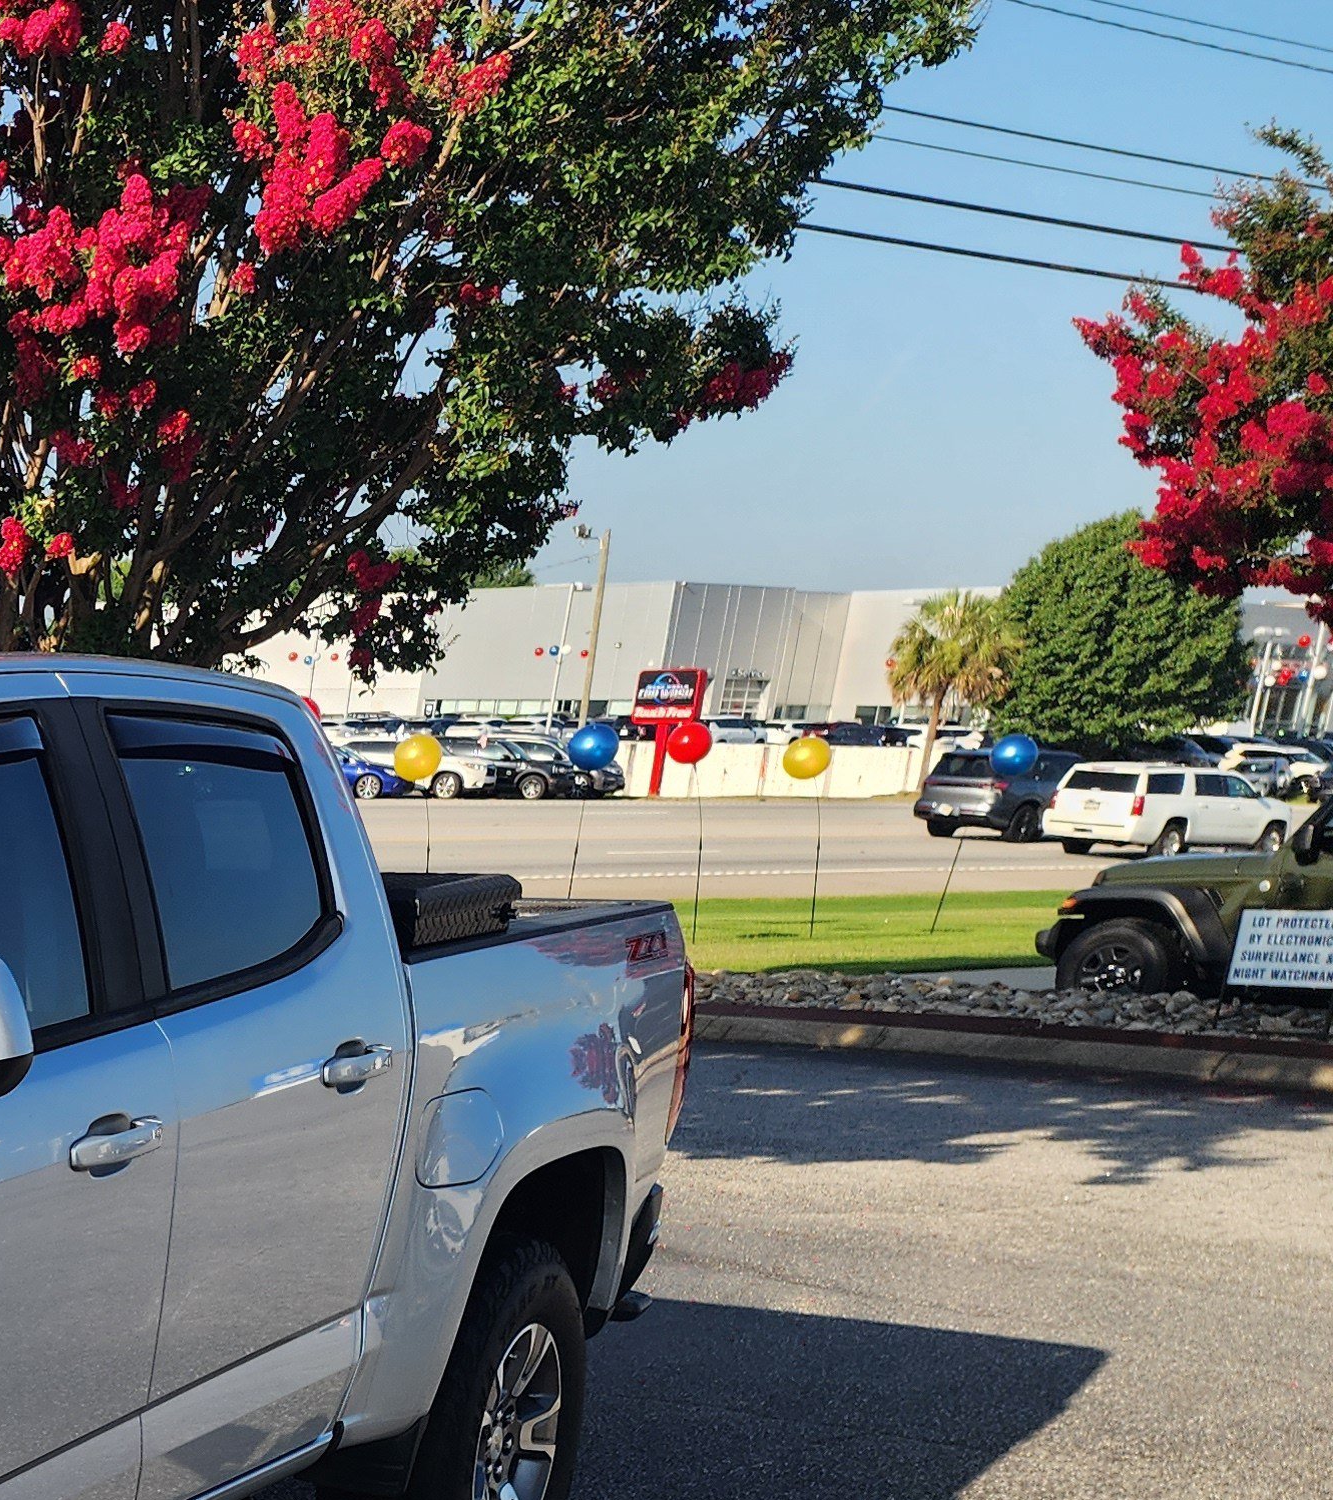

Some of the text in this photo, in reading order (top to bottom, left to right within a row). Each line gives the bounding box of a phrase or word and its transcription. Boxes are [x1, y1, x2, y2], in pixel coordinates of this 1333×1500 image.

[1252, 915, 1333, 929] LOT PROTECTE
[1249, 933, 1333, 947] BY ELECTRONIC
[625, 930, 668, 966] Z71
[1241, 950, 1321, 964] SURVEILLANCE
[1233, 967, 1333, 982] NIGHT WATCHMAN
